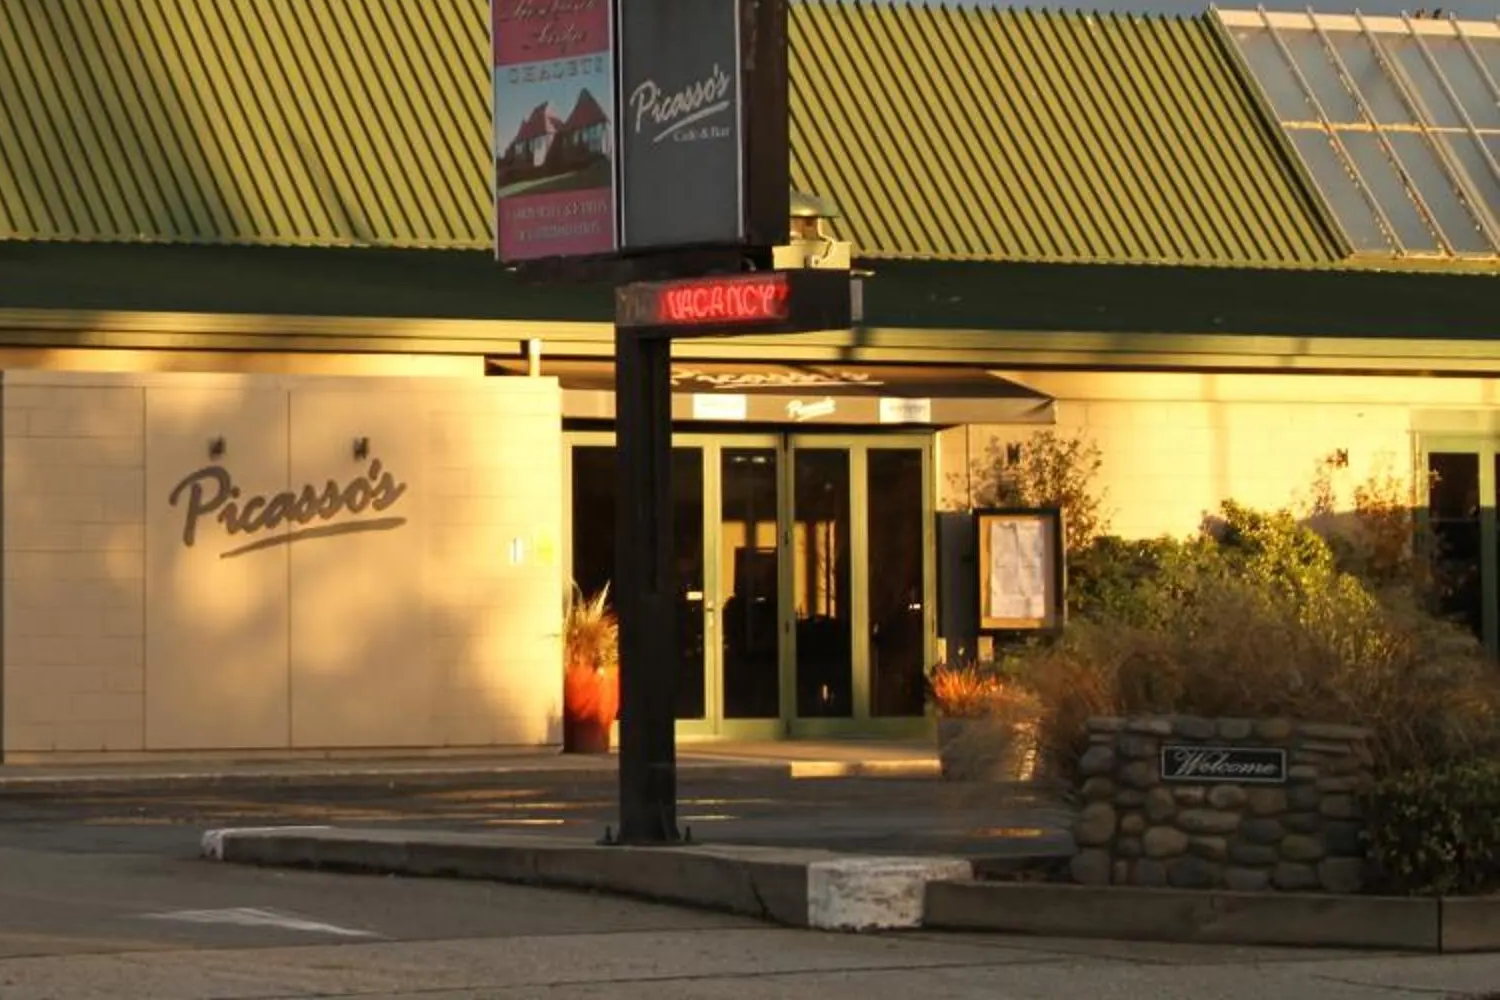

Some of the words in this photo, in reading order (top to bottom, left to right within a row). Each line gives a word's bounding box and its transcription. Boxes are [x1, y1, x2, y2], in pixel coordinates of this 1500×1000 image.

[629, 62, 731, 133] Picasso's
[666, 284, 775, 320] VACANCY
[168, 458, 407, 547] Picasso's
[1173, 750, 1279, 776] Welcome
